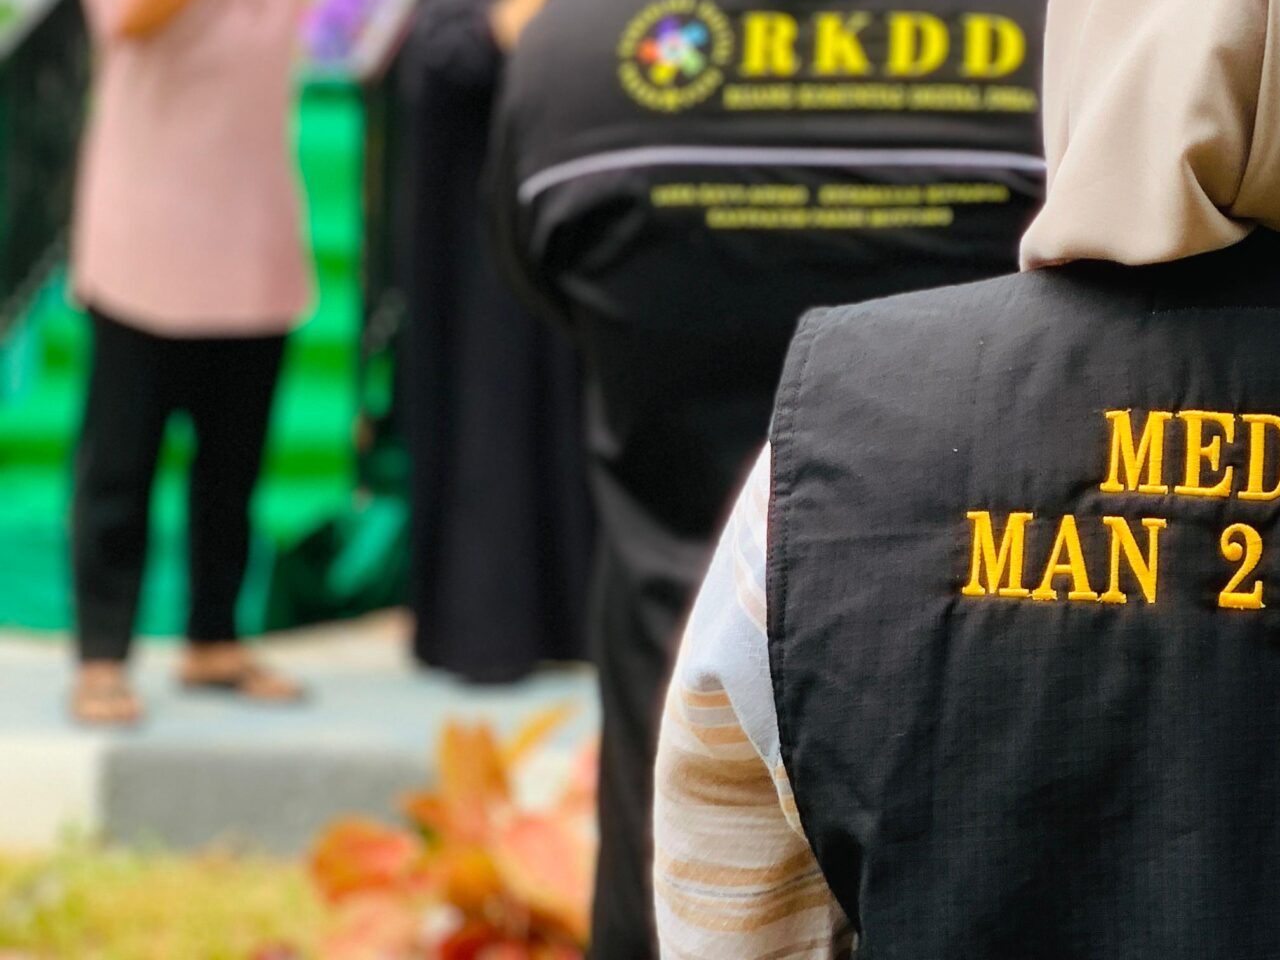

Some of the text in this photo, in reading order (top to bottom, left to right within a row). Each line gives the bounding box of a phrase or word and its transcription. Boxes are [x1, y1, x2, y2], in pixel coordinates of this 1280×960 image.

[739, 10, 1028, 78] RKDD
[961, 510, 1168, 604] MAN
[1218, 522, 1265, 609] 2
